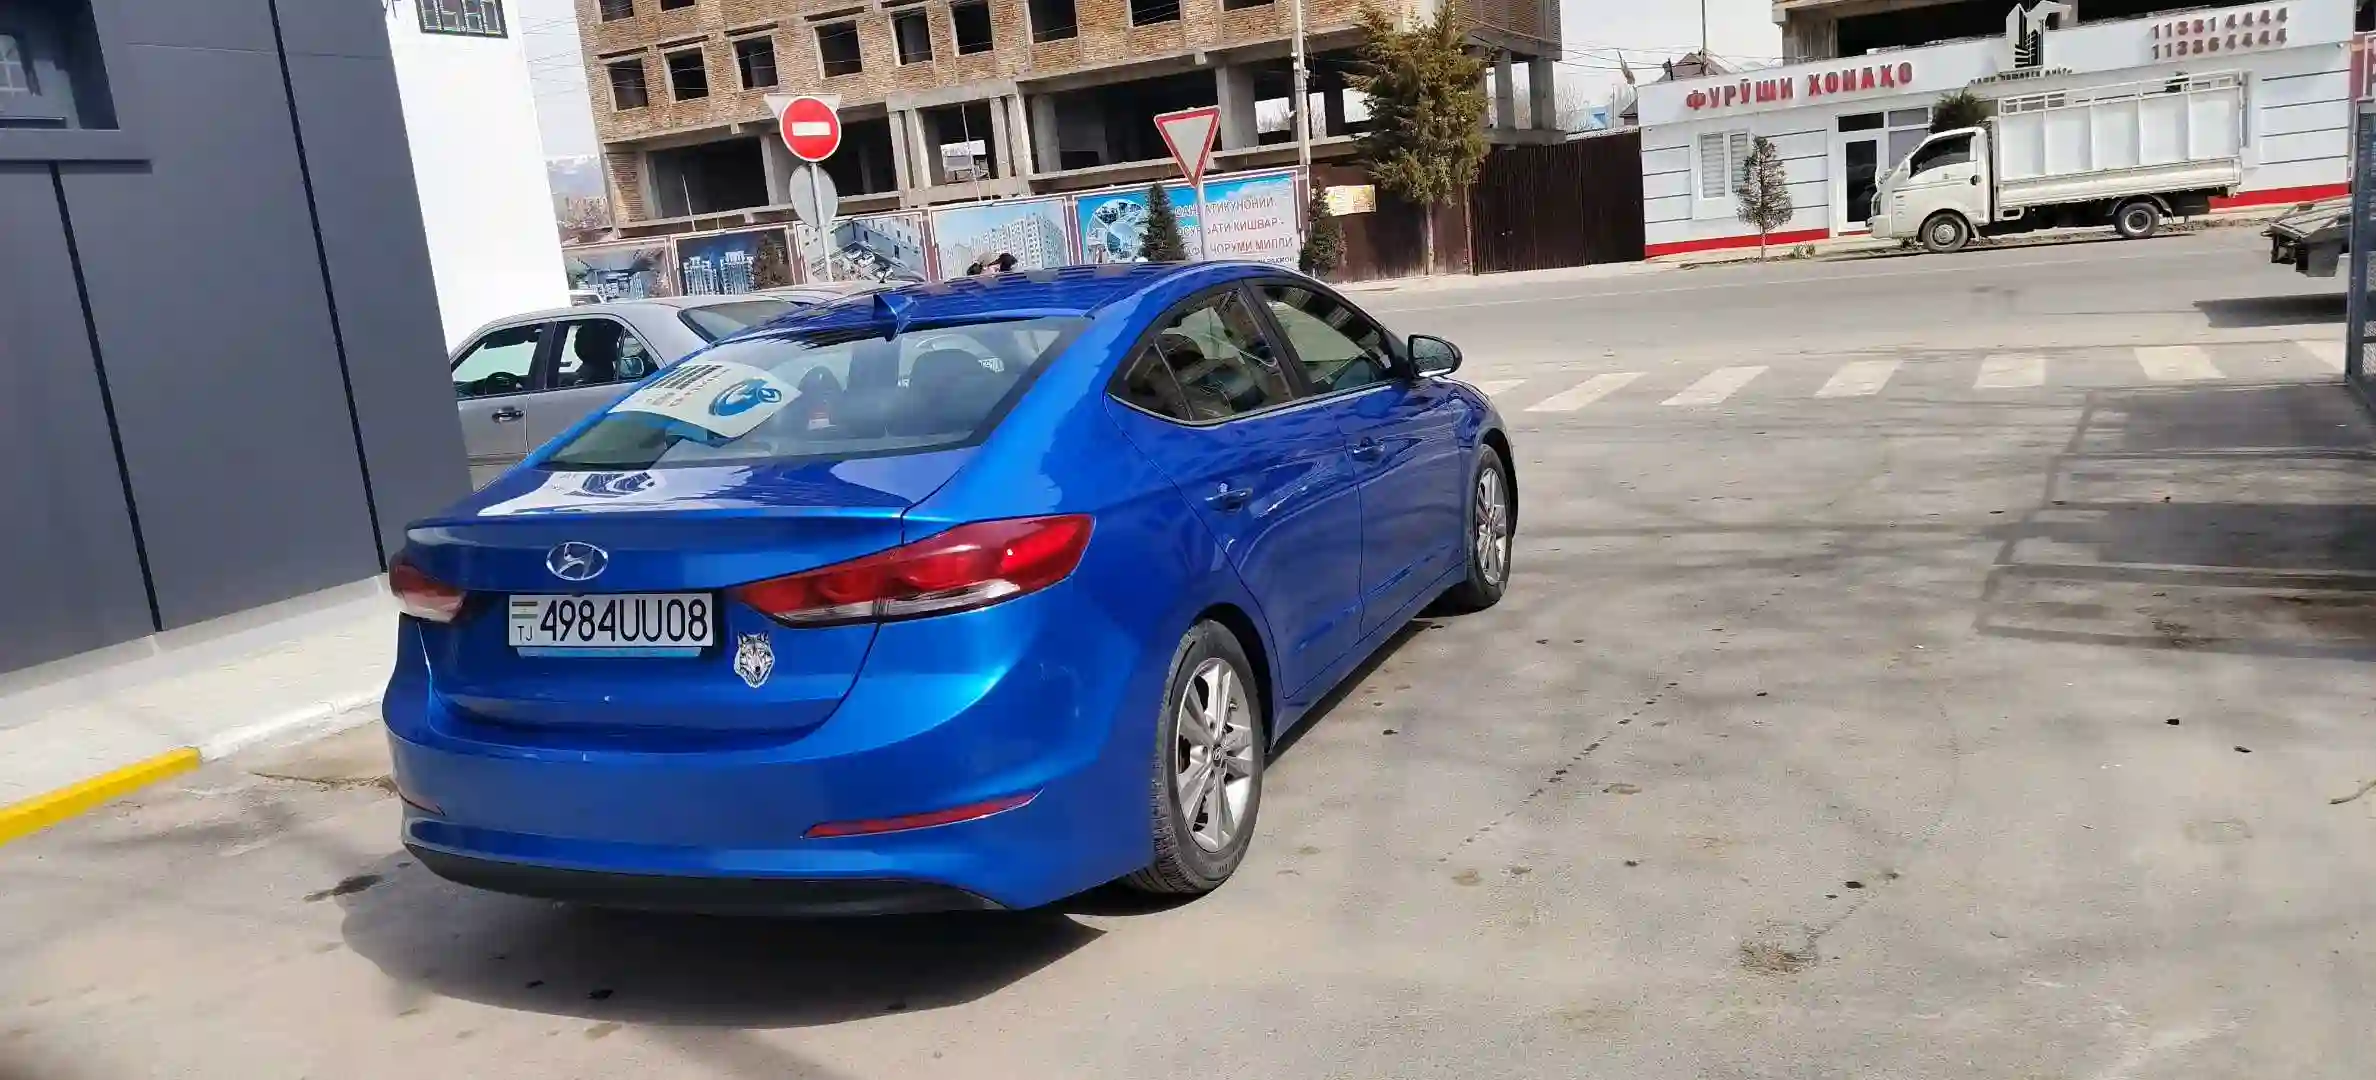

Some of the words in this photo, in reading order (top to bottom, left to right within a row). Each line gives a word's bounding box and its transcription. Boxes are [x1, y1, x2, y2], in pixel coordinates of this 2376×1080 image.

[1686, 77, 1794, 110] ФУРӮШИ
[517, 625, 533, 642] TJ
[540, 599, 708, 642] 4984UU08
